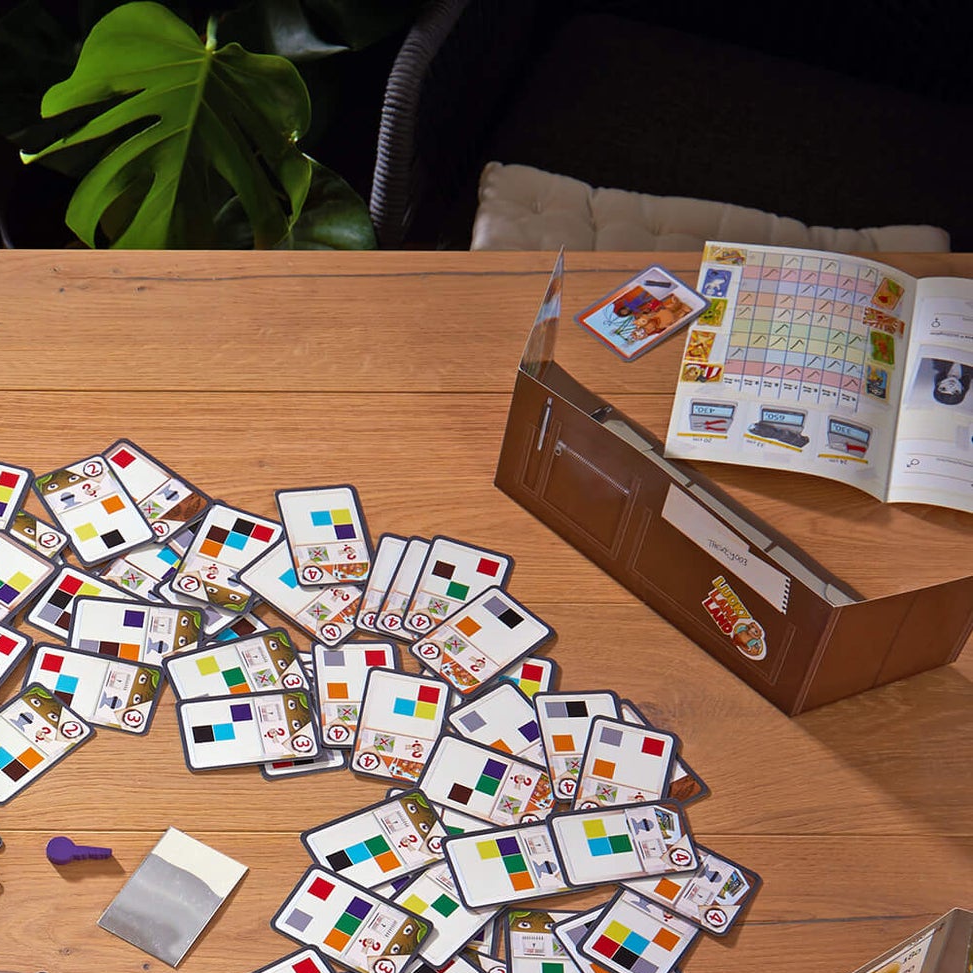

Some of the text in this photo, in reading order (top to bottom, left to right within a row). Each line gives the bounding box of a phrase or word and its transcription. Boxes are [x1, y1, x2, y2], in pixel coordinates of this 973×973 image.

[85, 464, 97, 478] 2
[308, 570, 317, 580] 4
[713, 577, 751, 620] LUCKY
[386, 616, 398, 628] 4
[412, 616, 425, 628] 4
[703, 598, 733, 635] LAND
[127, 714, 141, 723] 3
[65, 725, 79, 734] 2
[364, 756, 374, 767] 4
[565, 782, 574, 794] 4
[710, 912, 723, 923] 4
